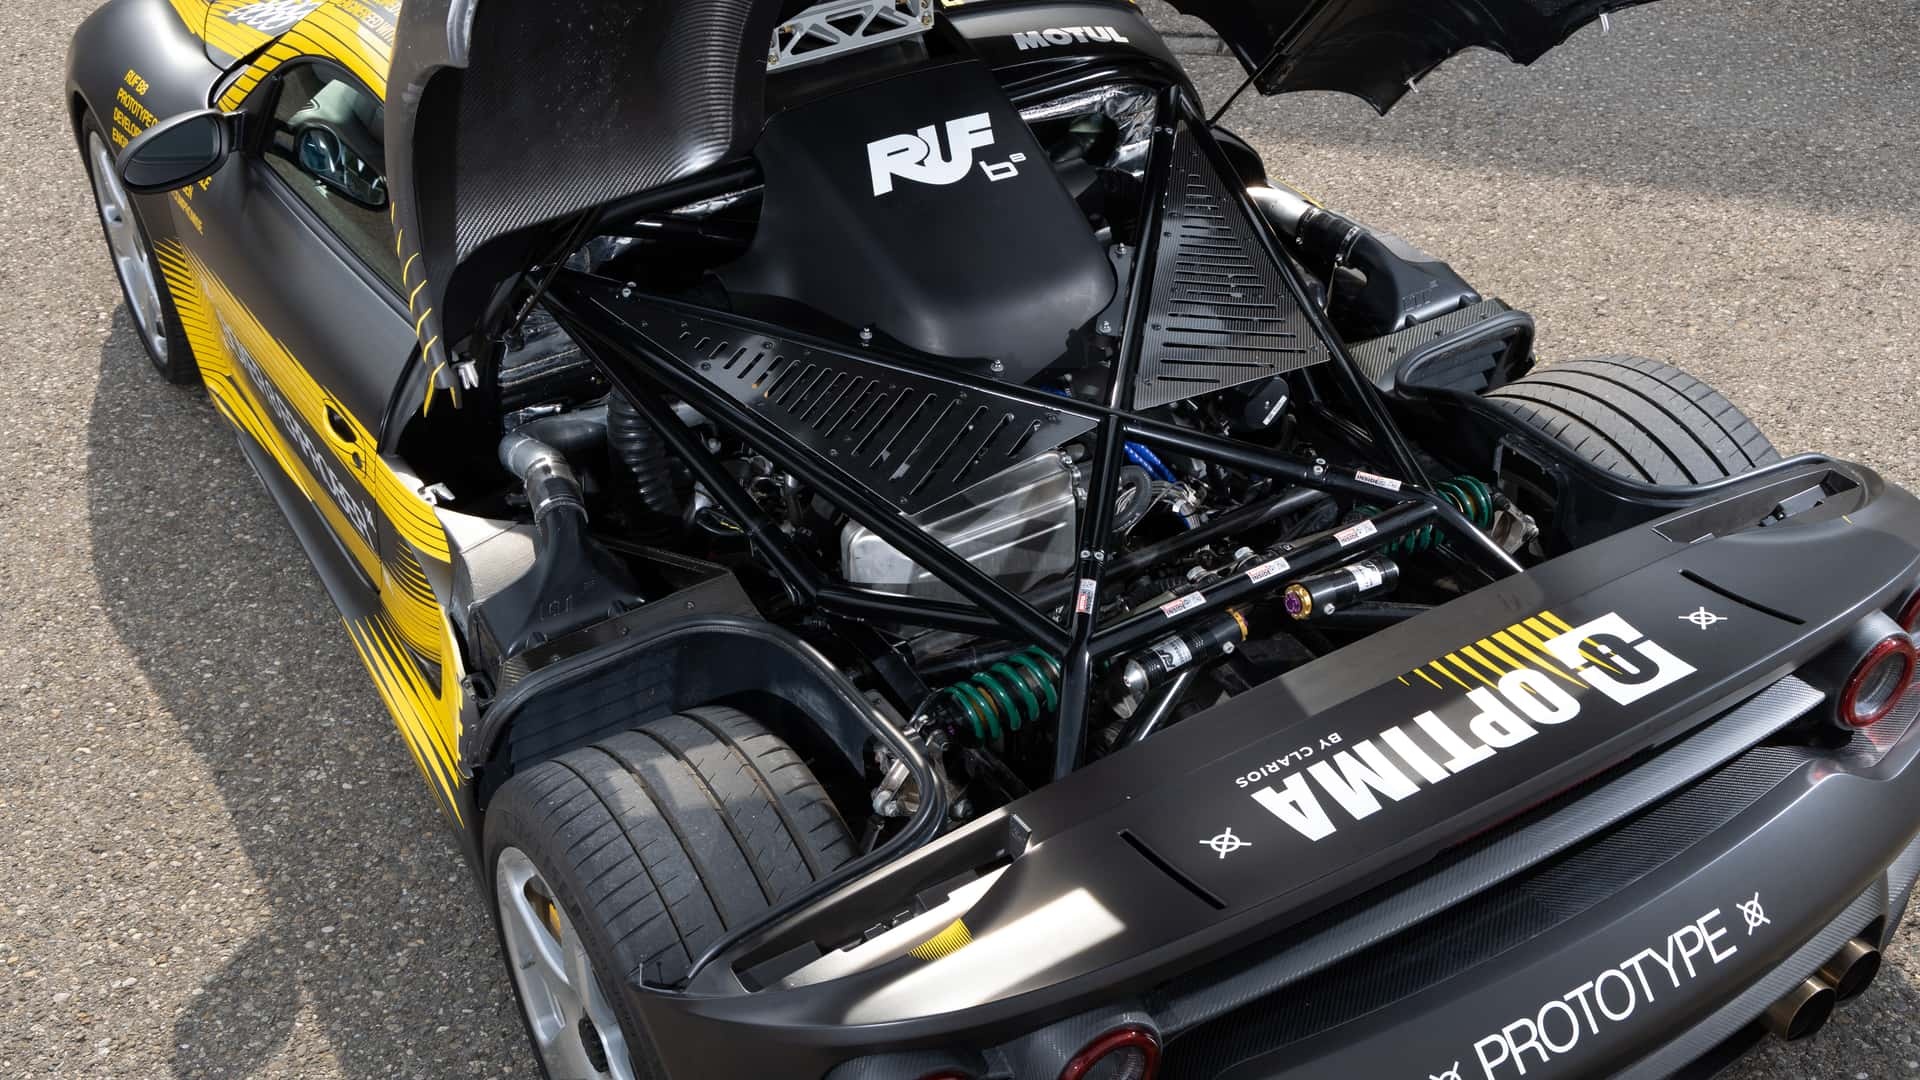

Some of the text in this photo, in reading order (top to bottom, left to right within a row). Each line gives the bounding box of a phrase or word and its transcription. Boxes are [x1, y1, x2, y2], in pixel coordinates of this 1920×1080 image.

[1012, 26, 1129, 51] MOTUL
[123, 69, 142, 88] RUF
[116, 87, 154, 129] PROTOTYPE
[866, 112, 996, 197] RUF
[1235, 732, 1343, 788] BY CLARIOS
[1251, 668, 1581, 842] OPTIMA
[1473, 908, 1738, 1080] PROTOTYPE
